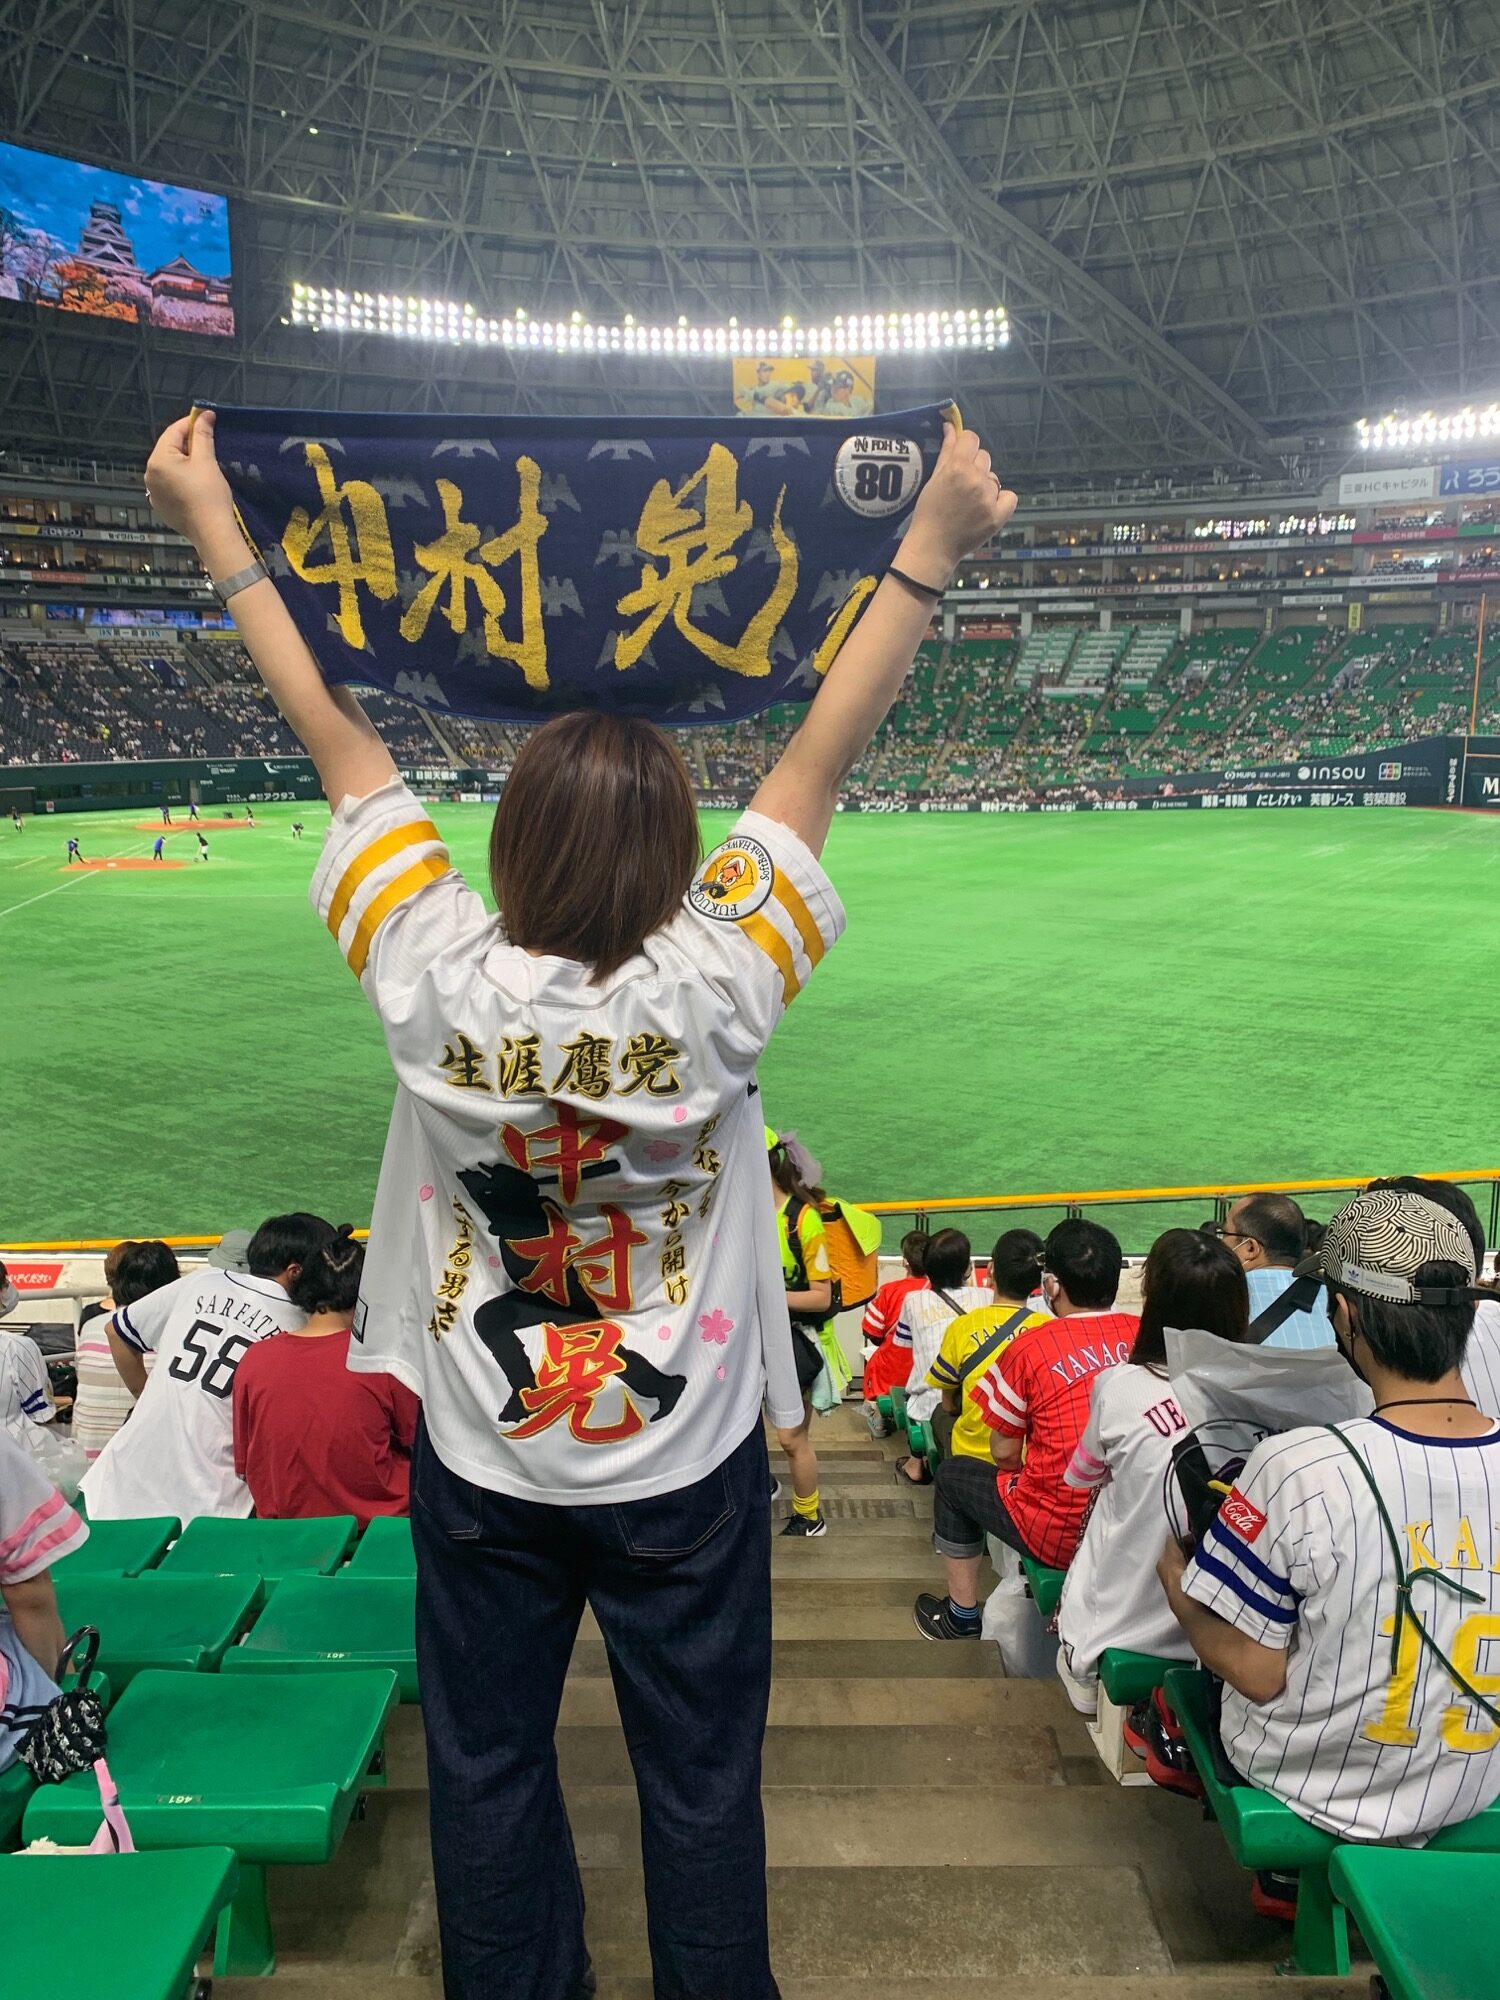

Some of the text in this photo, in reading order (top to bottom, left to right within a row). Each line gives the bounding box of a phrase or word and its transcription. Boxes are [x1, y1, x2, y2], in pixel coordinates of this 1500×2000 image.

[855, 462, 904, 502] 80
[860, 801, 908, 813] サニクリーン
[1256, 793, 1303, 807] にしけい
[438, 1033, 684, 1099] 生涯鷹党
[500, 1100, 649, 1444] 中村晃
[1051, 1337, 1135, 1387] YANAG
